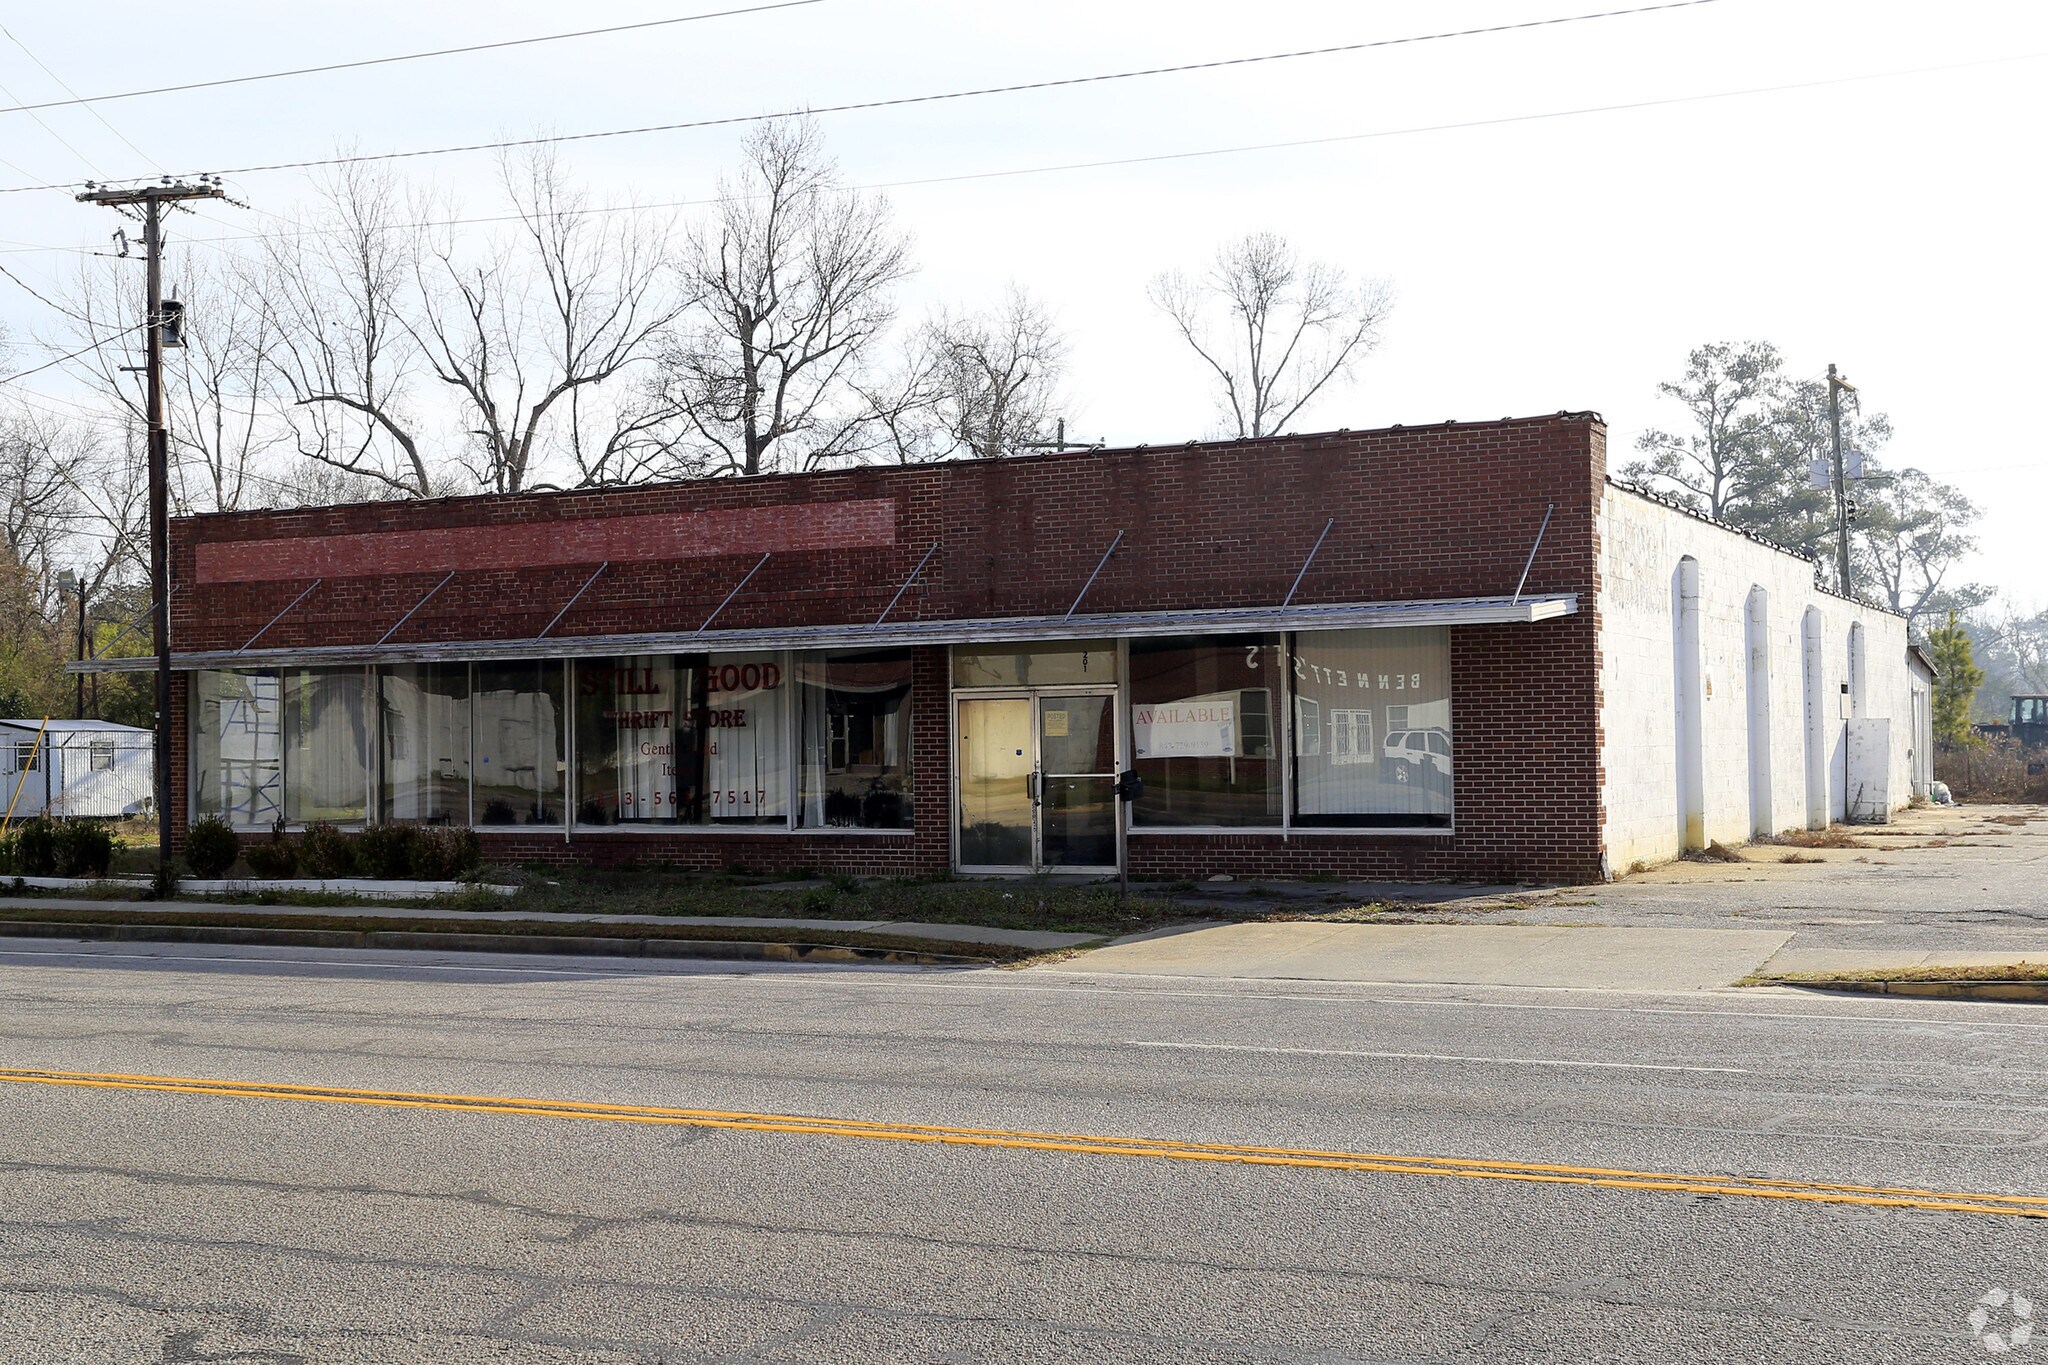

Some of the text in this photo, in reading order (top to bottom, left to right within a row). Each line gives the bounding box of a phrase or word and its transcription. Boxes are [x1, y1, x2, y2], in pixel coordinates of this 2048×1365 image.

[580, 662, 781, 696] STILL GOOD
[604, 709, 747, 730] THRIFT STORE
[1135, 707, 1231, 726] AVAILABLE
[640, 742, 680, 757] Gentl
